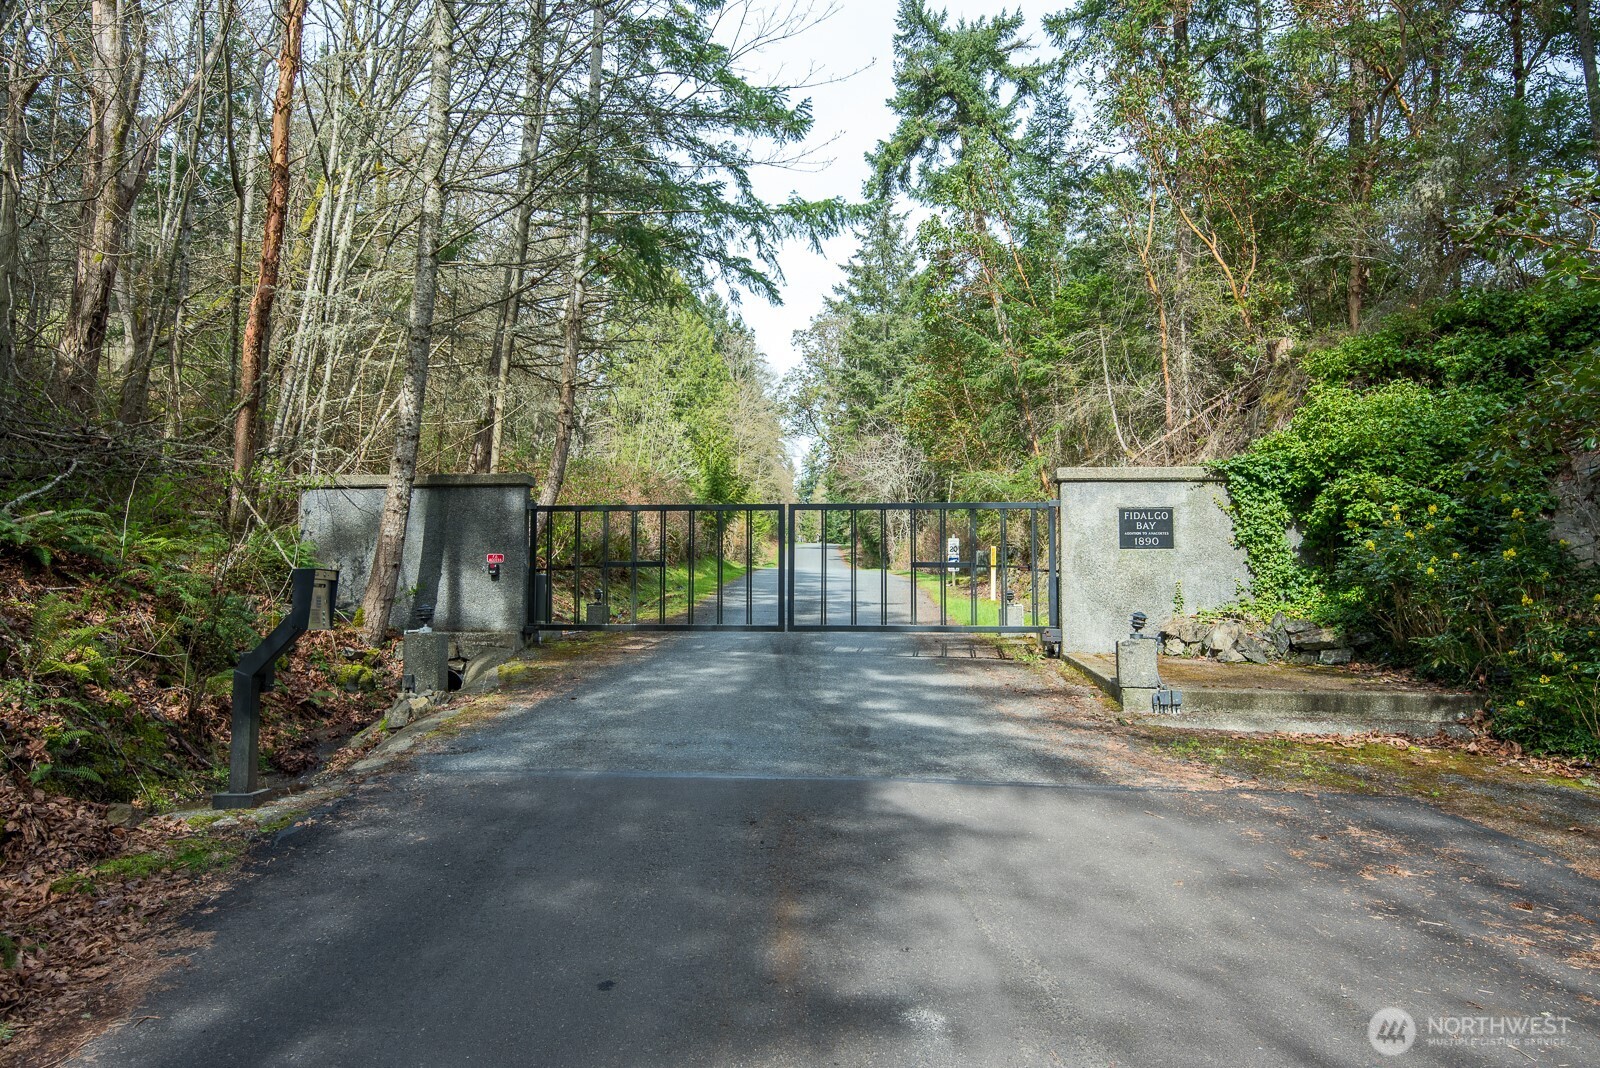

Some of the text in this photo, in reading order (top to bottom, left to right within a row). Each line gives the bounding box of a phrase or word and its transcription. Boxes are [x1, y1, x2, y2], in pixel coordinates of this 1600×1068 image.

[1124, 511, 1169, 520] FIDALGO
[1136, 521, 1157, 530] BAY
[1134, 537, 1159, 546] 1890
[949, 545, 958, 553] 20
